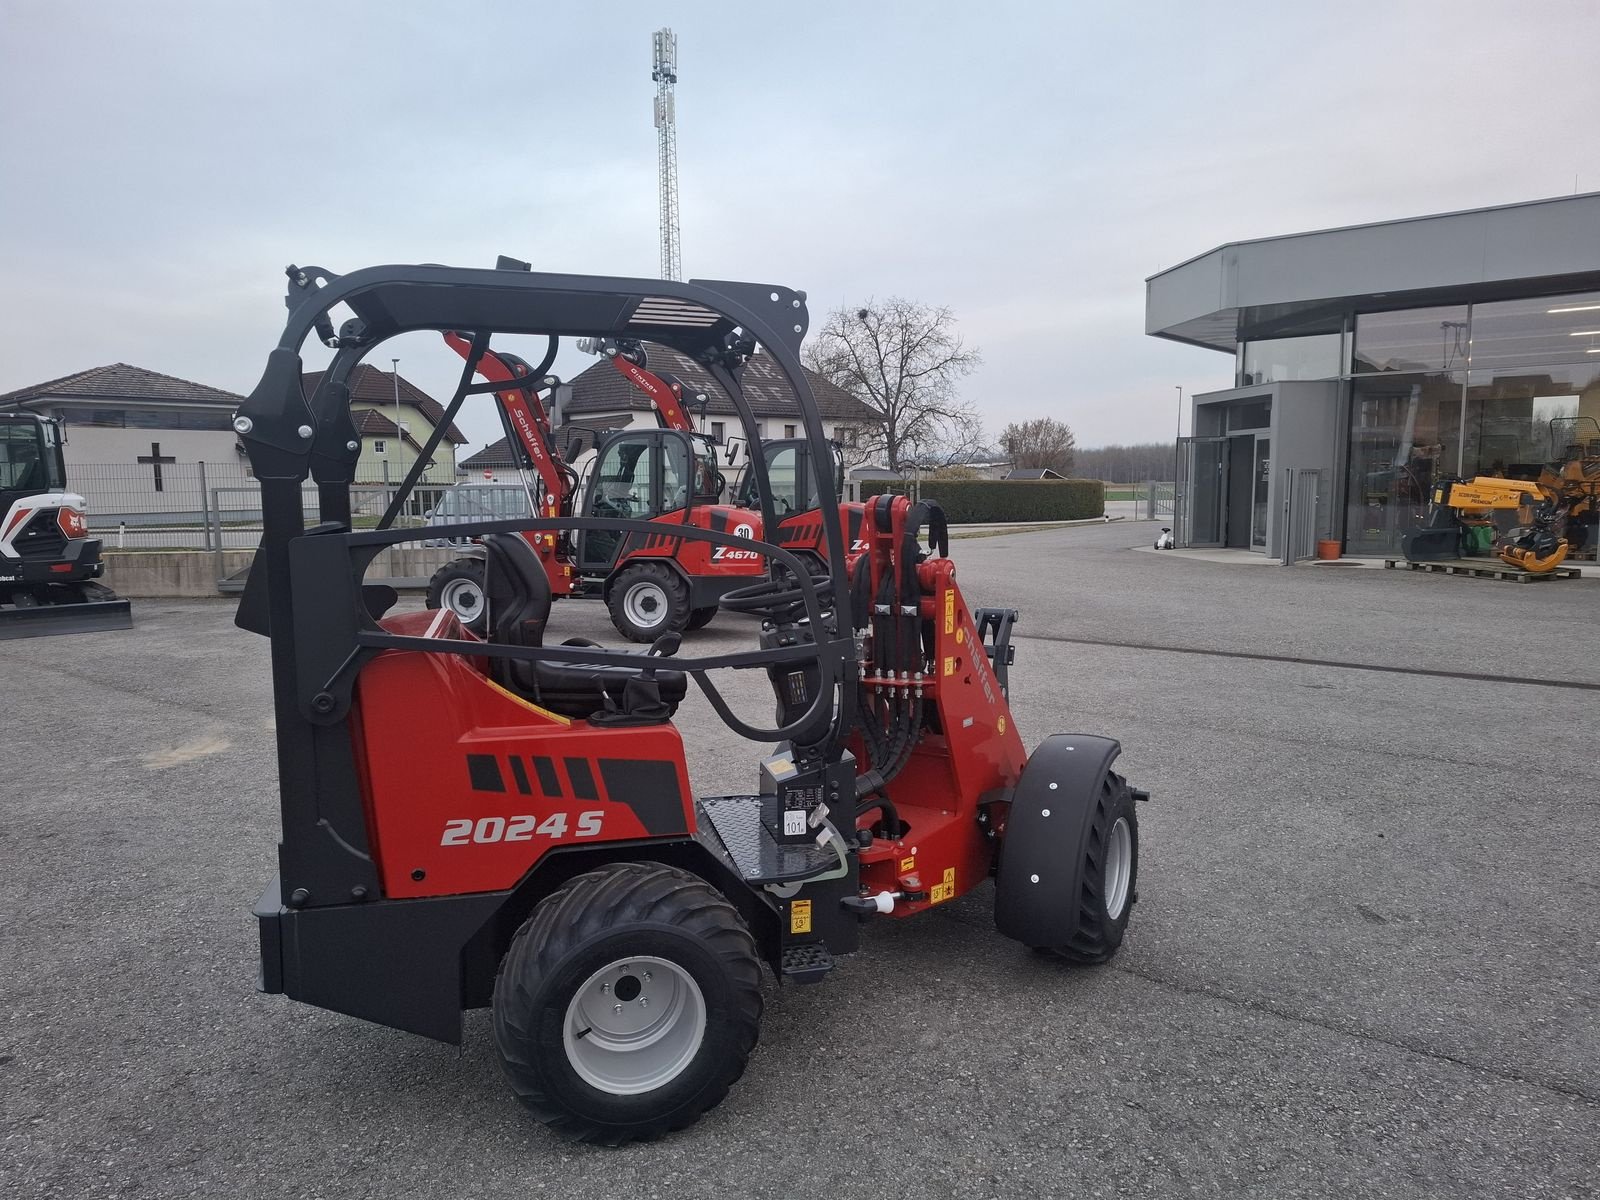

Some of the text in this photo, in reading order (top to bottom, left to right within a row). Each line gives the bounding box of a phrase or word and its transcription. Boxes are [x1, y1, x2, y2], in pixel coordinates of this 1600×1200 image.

[513, 408, 543, 460] Schäffer
[738, 528, 750, 539] 30
[712, 547, 758, 559] Z4670
[963, 618, 995, 704] chäffer
[440, 811, 604, 847] 2024 S
